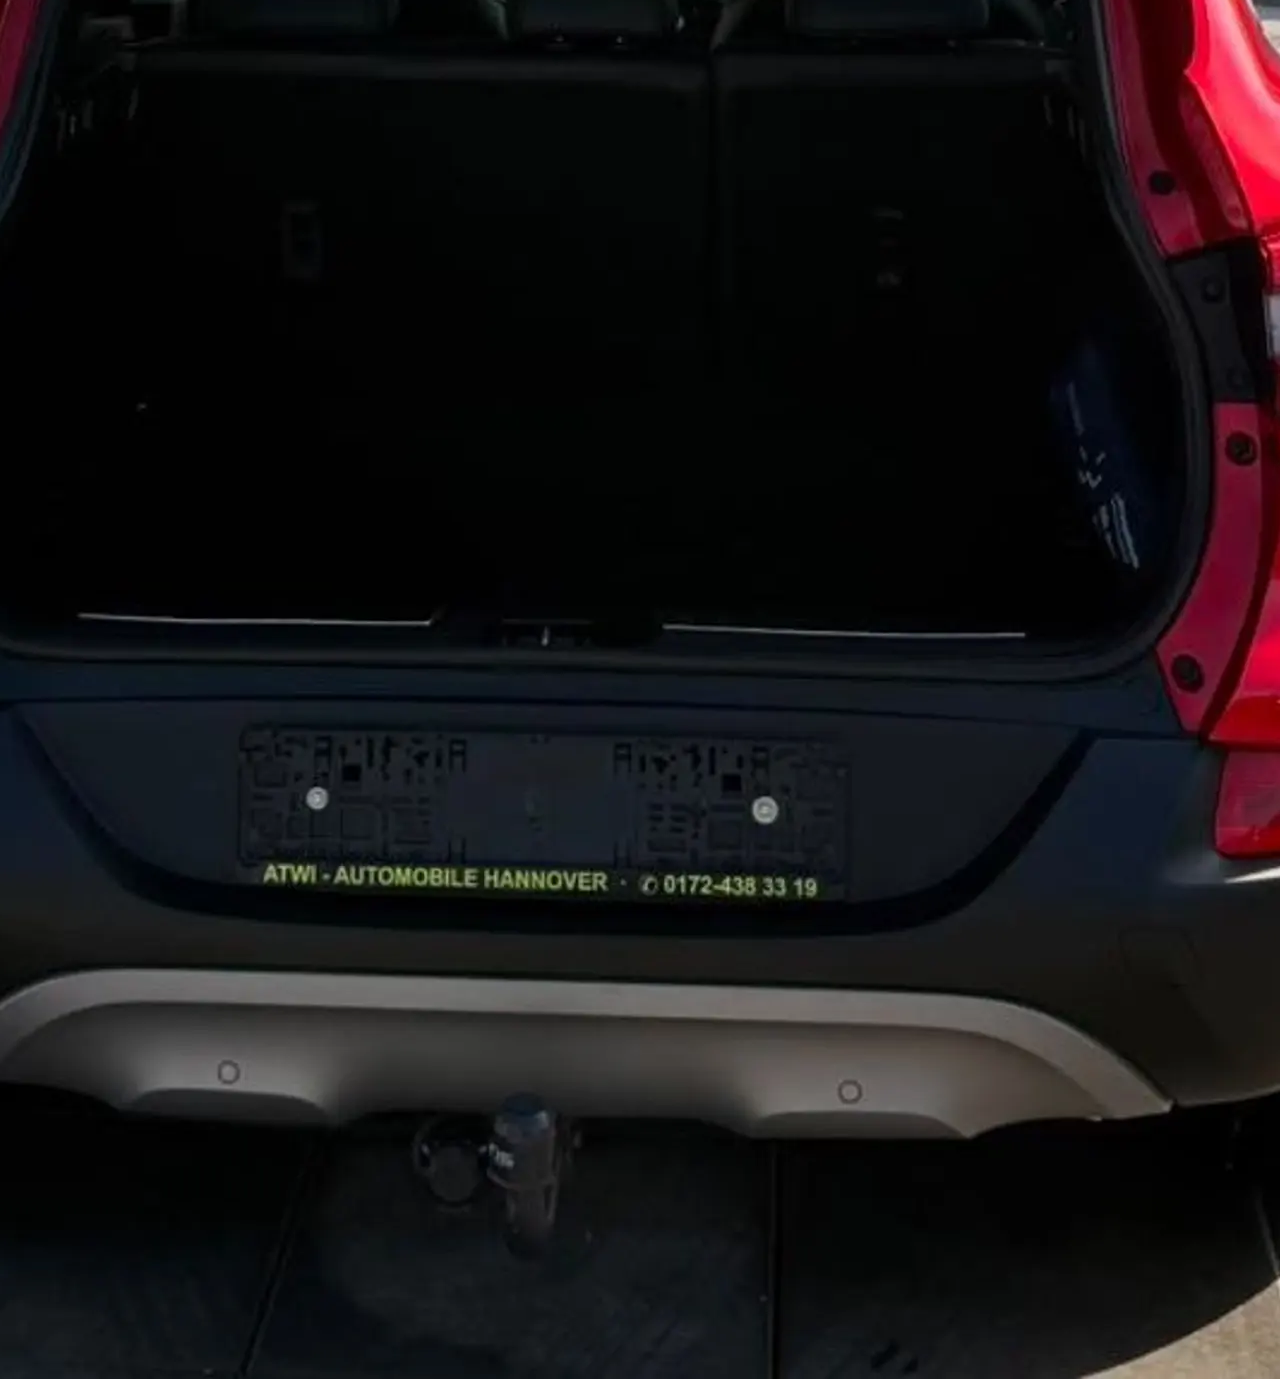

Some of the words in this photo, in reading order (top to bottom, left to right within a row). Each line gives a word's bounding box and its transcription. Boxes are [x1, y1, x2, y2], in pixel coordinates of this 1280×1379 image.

[263, 864, 317, 884] ATWI
[333, 865, 479, 888] AUTOMOBILE
[483, 869, 609, 892] HANNOVER
[663, 874, 758, 898] 0172-438
[762, 876, 788, 898] 33
[792, 877, 818, 899] 19
